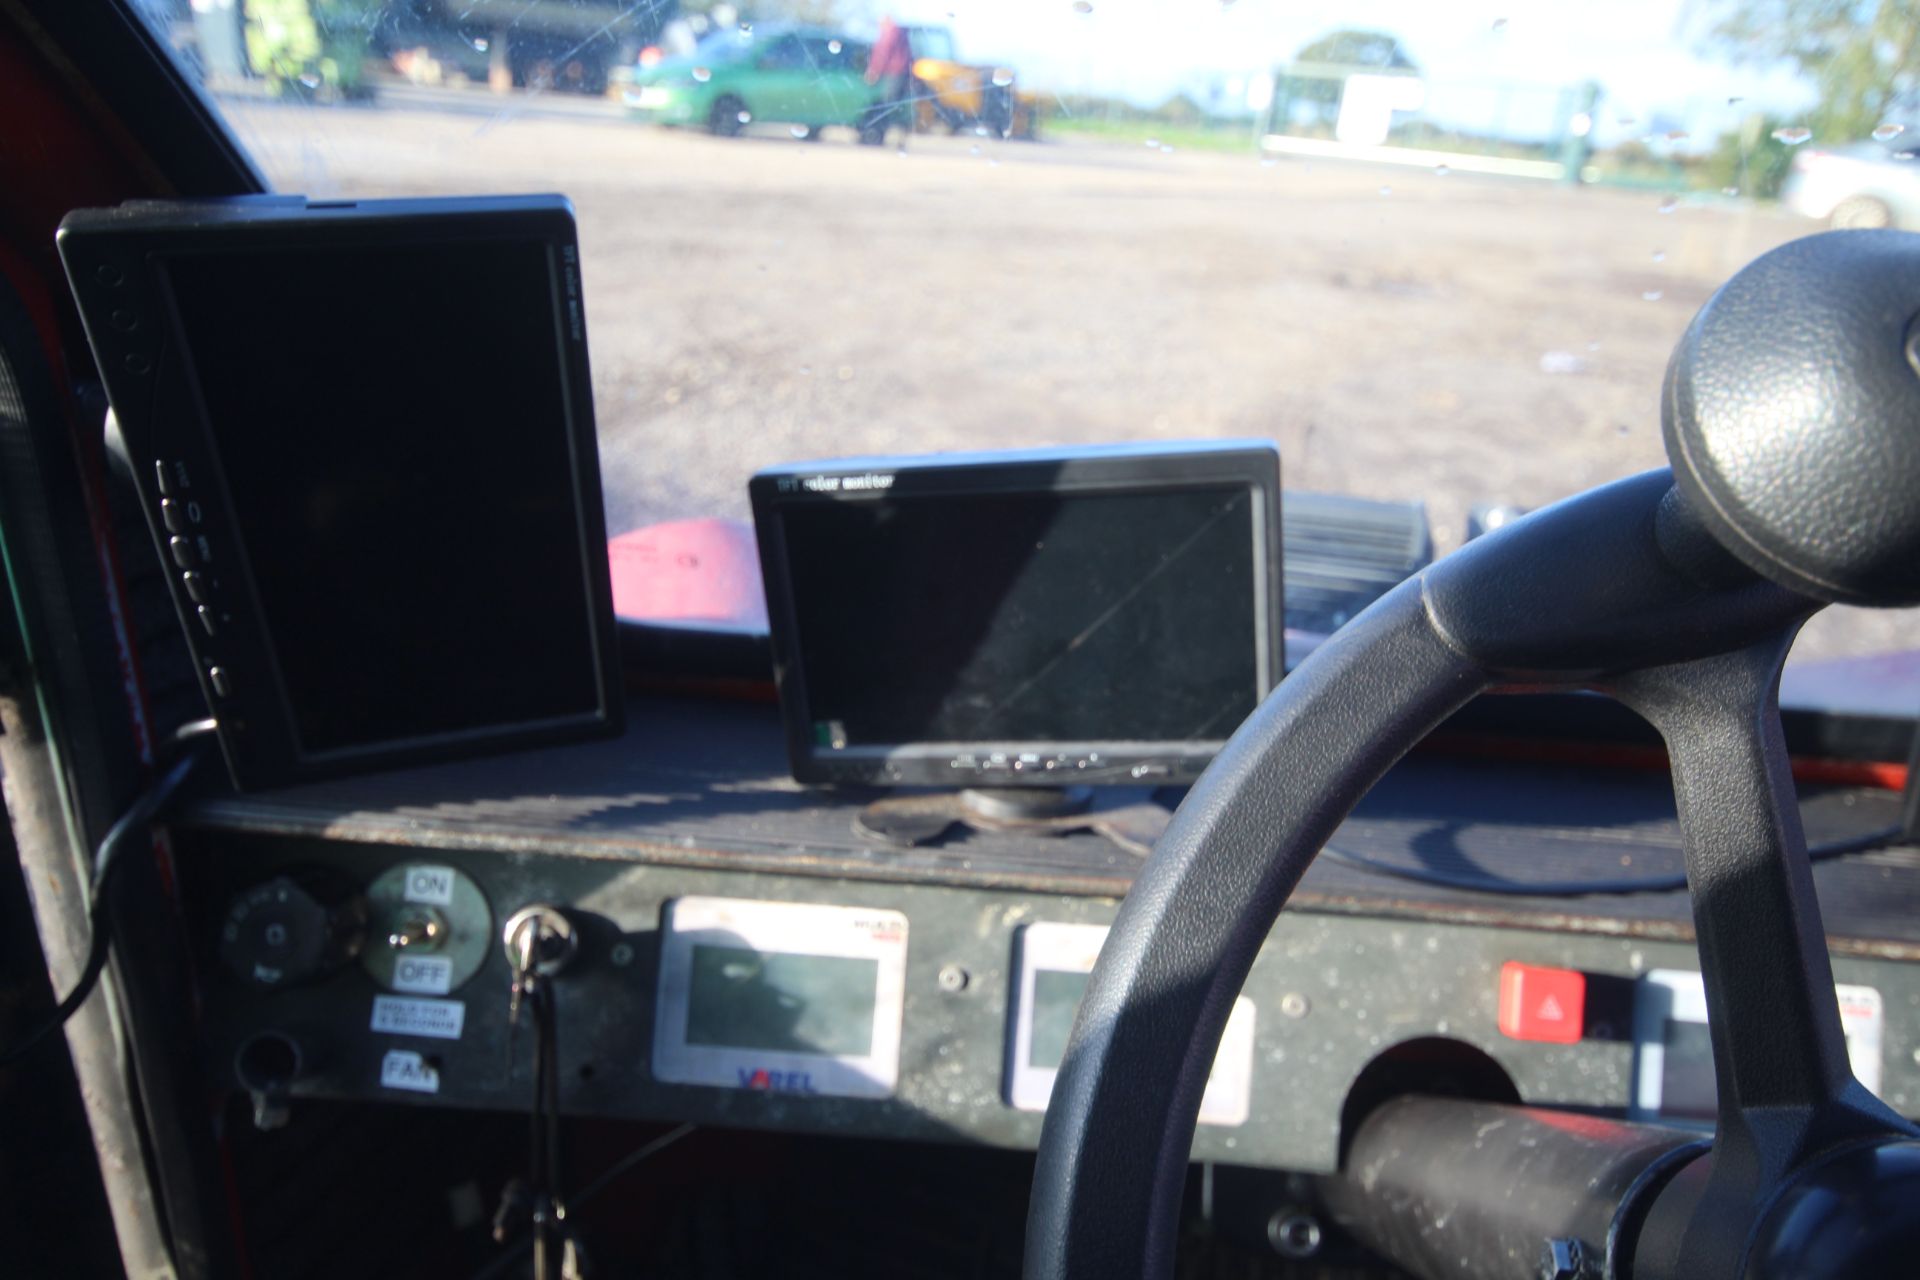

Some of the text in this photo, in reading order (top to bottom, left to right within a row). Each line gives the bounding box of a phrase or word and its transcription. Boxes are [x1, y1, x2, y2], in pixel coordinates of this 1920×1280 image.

[803, 474, 840, 491] color
[842, 472, 894, 490] monitor
[412, 870, 446, 893] ON
[399, 961, 445, 985] OFF
